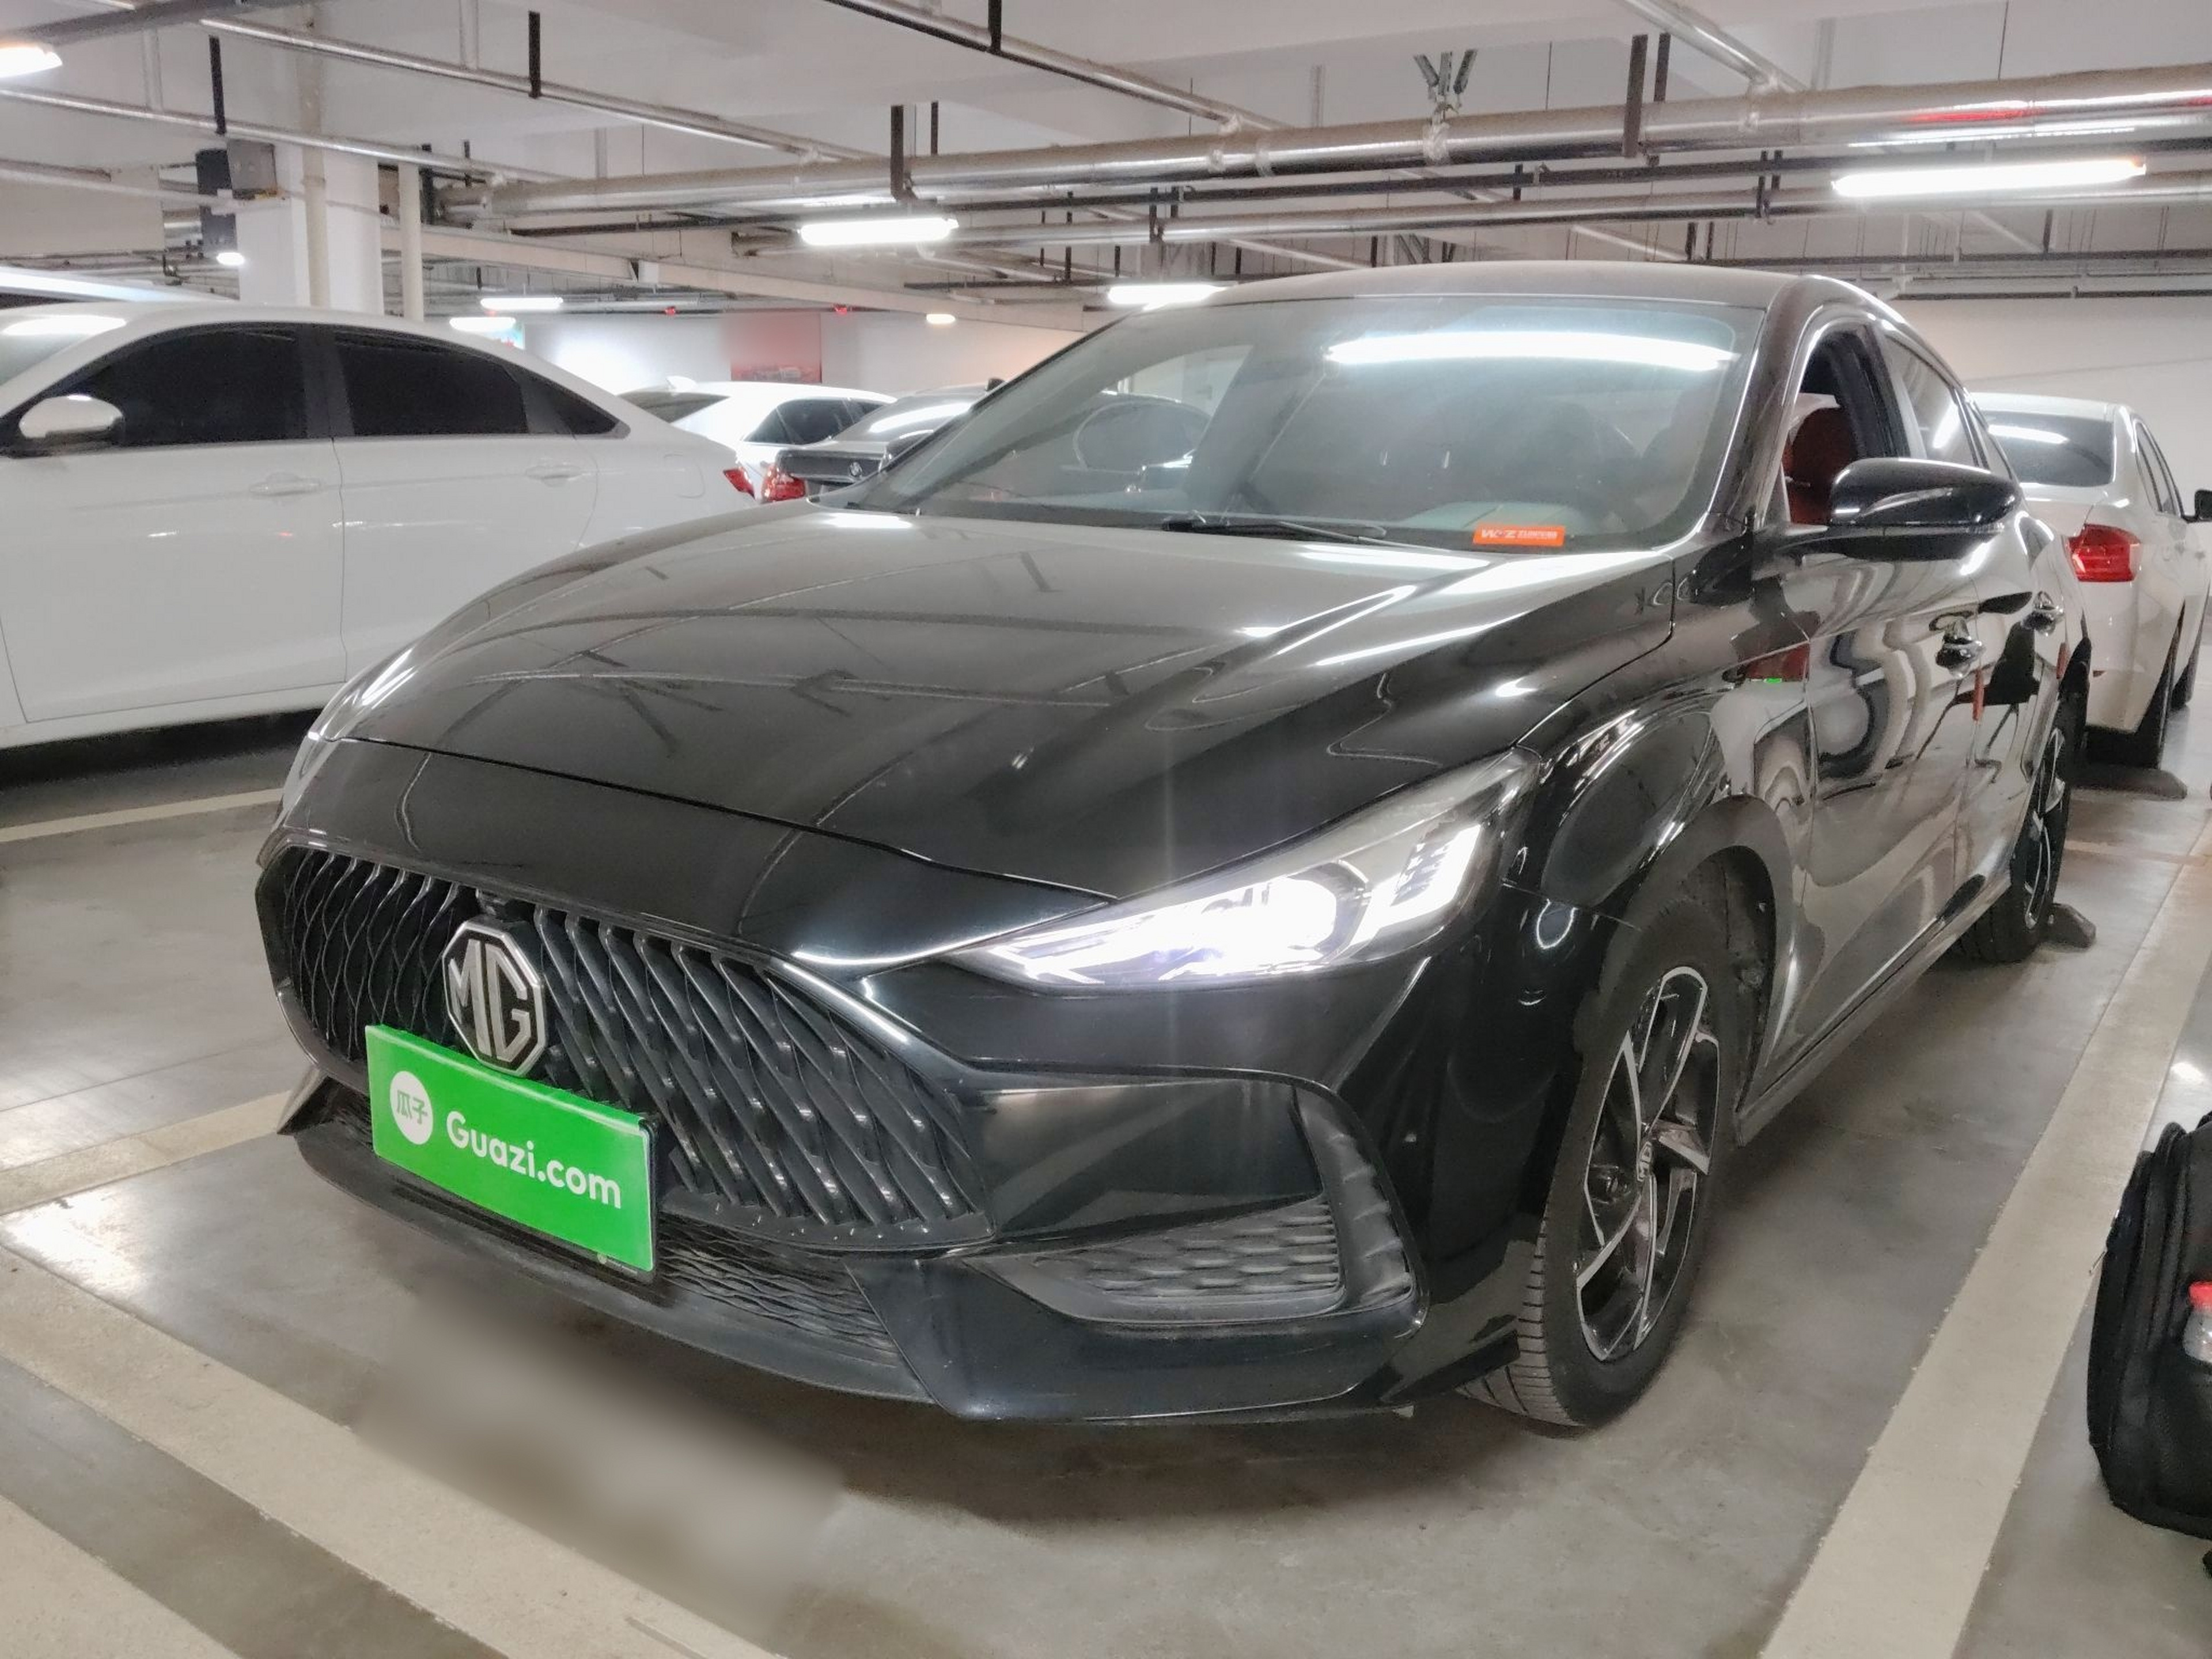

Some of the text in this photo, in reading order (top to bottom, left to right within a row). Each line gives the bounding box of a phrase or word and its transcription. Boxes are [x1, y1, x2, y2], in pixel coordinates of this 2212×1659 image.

[448, 938, 531, 1062] MG
[397, 1089, 428, 1125] 瓜子
[446, 1111, 621, 1209] Guazi.com
